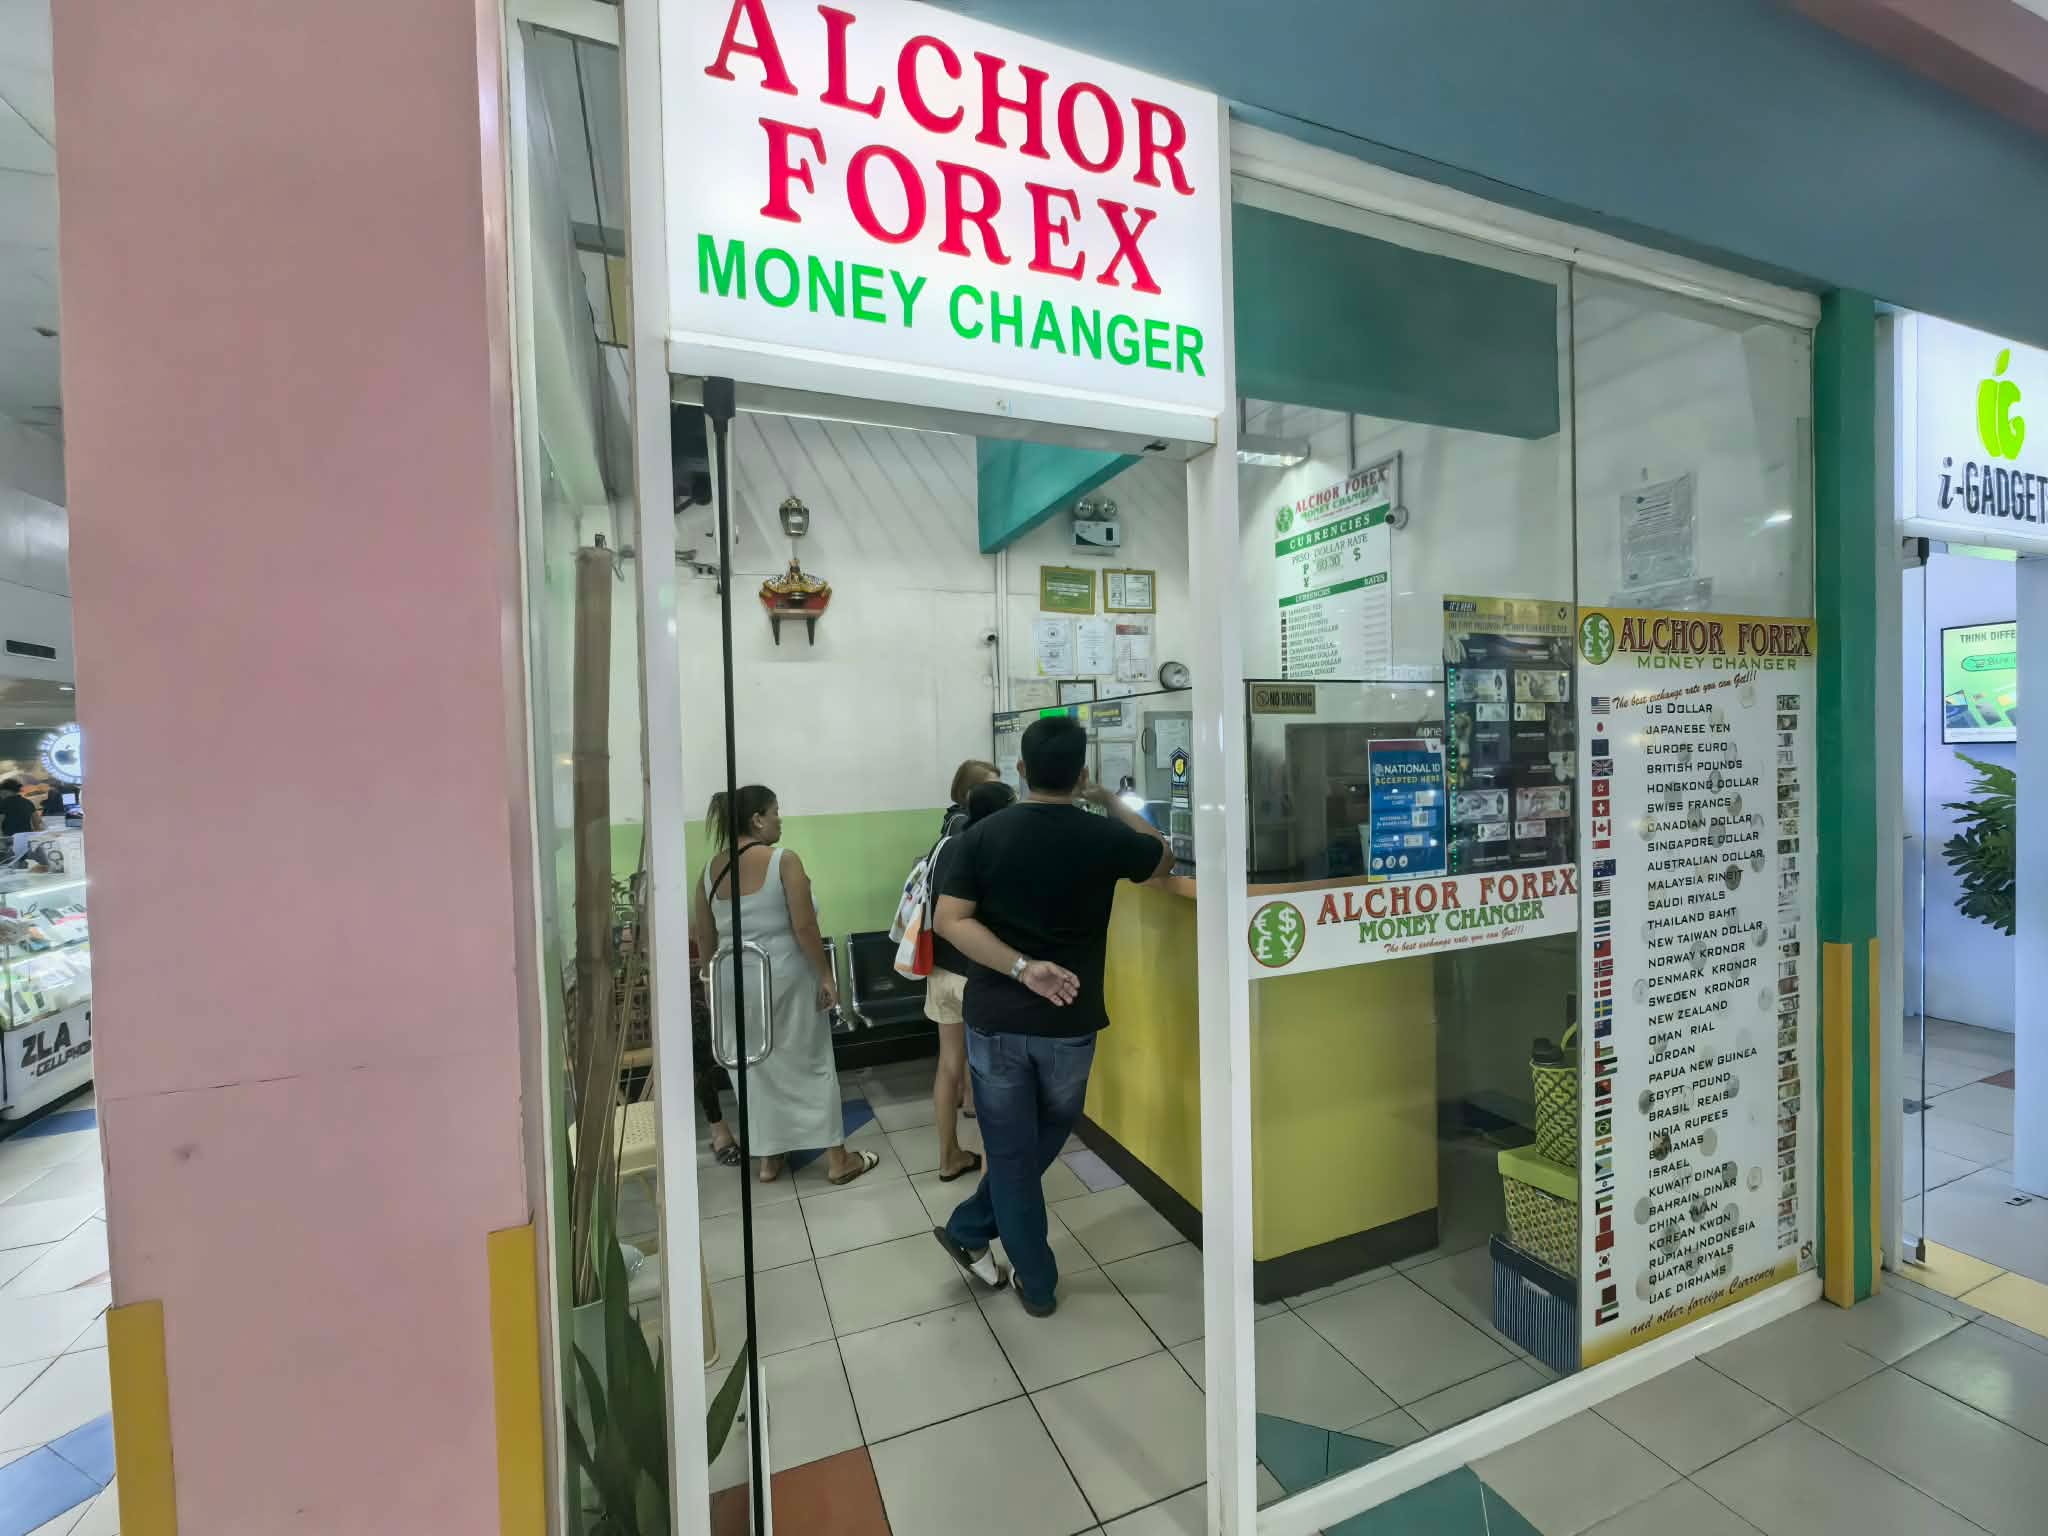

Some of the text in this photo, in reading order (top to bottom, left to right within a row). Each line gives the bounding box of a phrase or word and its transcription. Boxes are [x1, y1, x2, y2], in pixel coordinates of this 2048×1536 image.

[704, 0, 1195, 195] ALCHOR
[758, 117, 1162, 294] FOREX
[697, 233, 1205, 376] MONEY CHANGER
[1296, 486, 1340, 513] ALCHOR
[1345, 467, 1387, 495] FOREX
[1289, 513, 1371, 550] CURRENCIES
[1346, 532, 1368, 547] RATE
[1619, 617, 1812, 656] ALCHOR FOREX
[1960, 632, 1987, 643] THINK
[1638, 655, 1797, 671] MONEY CHANGER
[1270, 691, 1280, 706] NO
[1613, 696, 1629, 710] The
[1631, 694, 1647, 707] best
[1650, 687, 1682, 705] exchange
[1685, 684, 1700, 696] rate
[1702, 681, 1717, 693] you
[1718, 679, 1731, 689] can
[1646, 702, 1713, 714] US DOLLAR
[1646, 723, 1731, 735] JAPANESE YEN
[1646, 742, 1728, 755] EUROPE EURO
[1384, 763, 1441, 774] NATIONAL ID
[1647, 759, 1743, 774] BRITISH POUNDS
[1376, 776, 1417, 785] ACCEPTED
[1647, 777, 1759, 794] HONGKONG DOLLAR
[1647, 797, 1731, 813] SWISS FRANCS
[1648, 814, 1752, 833] CANADIAN DOLLAR
[1648, 831, 1759, 852] SINGAPORE DOLLAR
[1648, 849, 1764, 872] AUSTRALIAN DOLLAR
[1317, 867, 1578, 925] ALCHOR FOREX
[1648, 875, 1704, 891] MALAYSIA
[1648, 890, 1726, 911] SAUDI RIYALS
[1358, 900, 1545, 944] MONEY CHANGER
[1648, 906, 1737, 930] THAILAND BAHT
[1384, 943, 1399, 953] The
[1402, 941, 1417, 951] best
[1648, 920, 1763, 949] NEW TAIWAN DOLLAR
[1648, 942, 1745, 969] NORWAY KRONOR
[1648, 957, 1757, 988] DENMARK KRONOR
[1648, 977, 1750, 1007] SWEDEN KRONOR
[1648, 1000, 1728, 1027] NEW ZEALAND
[21, 1021, 72, 1069] ZLA
[1648, 1021, 1716, 1046] OMAN RIAL
[1648, 1044, 1695, 1065] JORDAN
[1649, 1047, 1758, 1085] PAPUA NEW GUINEA
[1649, 1072, 1731, 1103] EGYPT POUND
[1649, 1090, 1729, 1122] BRASIL REAIS
[1649, 1109, 1728, 1141] INDIA RUPEES
[1649, 1159, 1690, 1179] ISRAEL
[1649, 1163, 1728, 1198] KUWAIT DINAR
[1649, 1178, 1737, 1216] BAHRAIN DINAR
[1649, 1213, 1685, 1234] CHINA
[1649, 1212, 1731, 1252] KOREAN KWON
[1649, 1221, 1756, 1268] RUPIAH INDONESIA
[1649, 1243, 1734, 1286] QUATAR RIYALS
[1649, 1265, 1728, 1305] UAE DIRHAMS
[1630, 1266, 1776, 1335] and other foreign Currency
